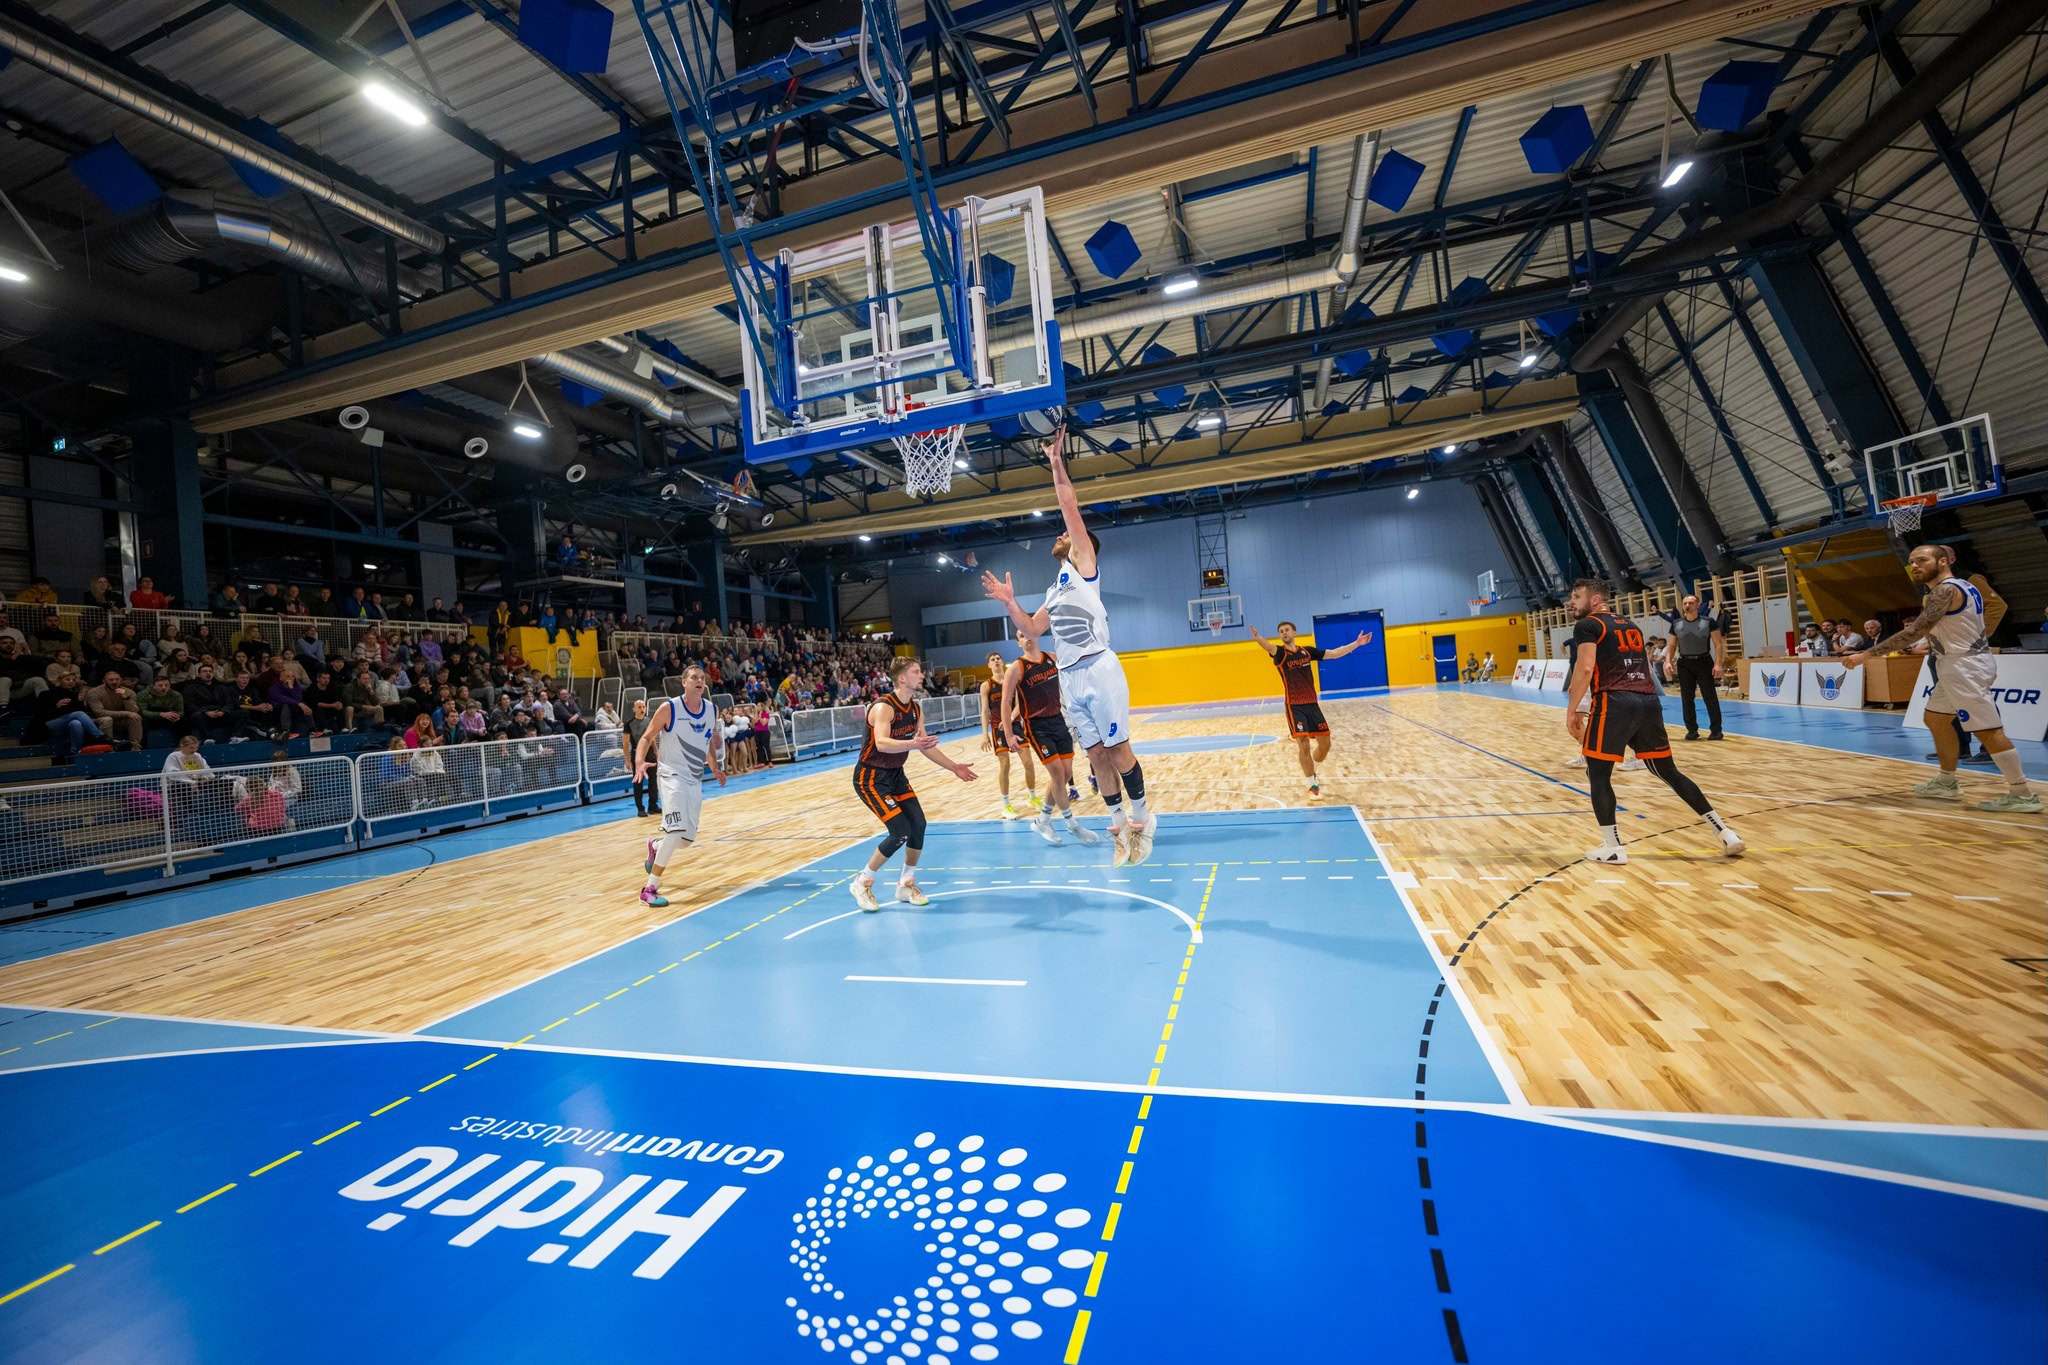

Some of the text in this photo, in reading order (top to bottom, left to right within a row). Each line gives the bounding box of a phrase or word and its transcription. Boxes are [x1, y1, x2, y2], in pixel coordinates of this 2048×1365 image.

[1614, 628, 1644, 652] 10
[1922, 685, 2041, 705] KTOR
[1108, 722, 1117, 737] 9
[338, 1146, 748, 1280] Hidria
